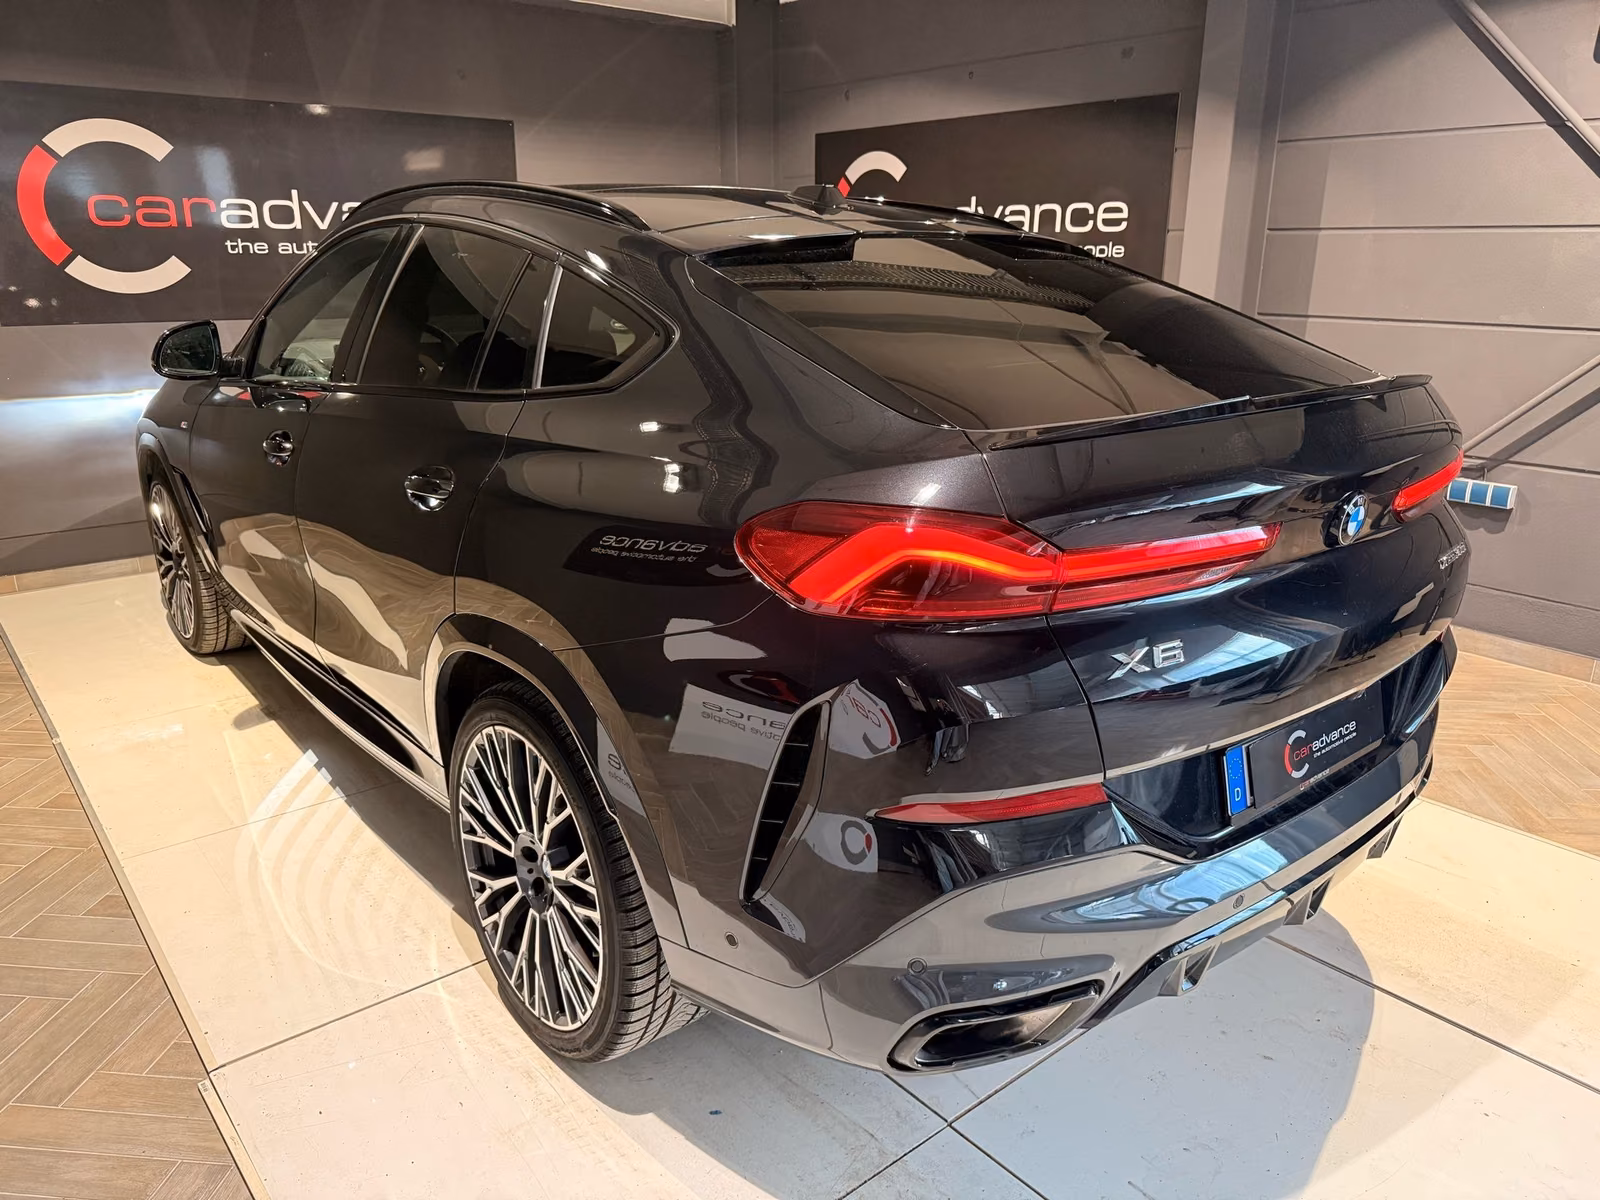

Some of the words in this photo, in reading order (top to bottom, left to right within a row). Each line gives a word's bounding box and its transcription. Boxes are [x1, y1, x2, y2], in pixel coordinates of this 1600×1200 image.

[225, 238, 269, 254] the
[1079, 241, 1125, 258] ople
[1107, 638, 1184, 681] X6
[1293, 721, 1357, 761] caradvance
[1321, 739, 1343, 754] automotive
[1344, 731, 1357, 743] people
[1234, 787, 1242, 802] D
